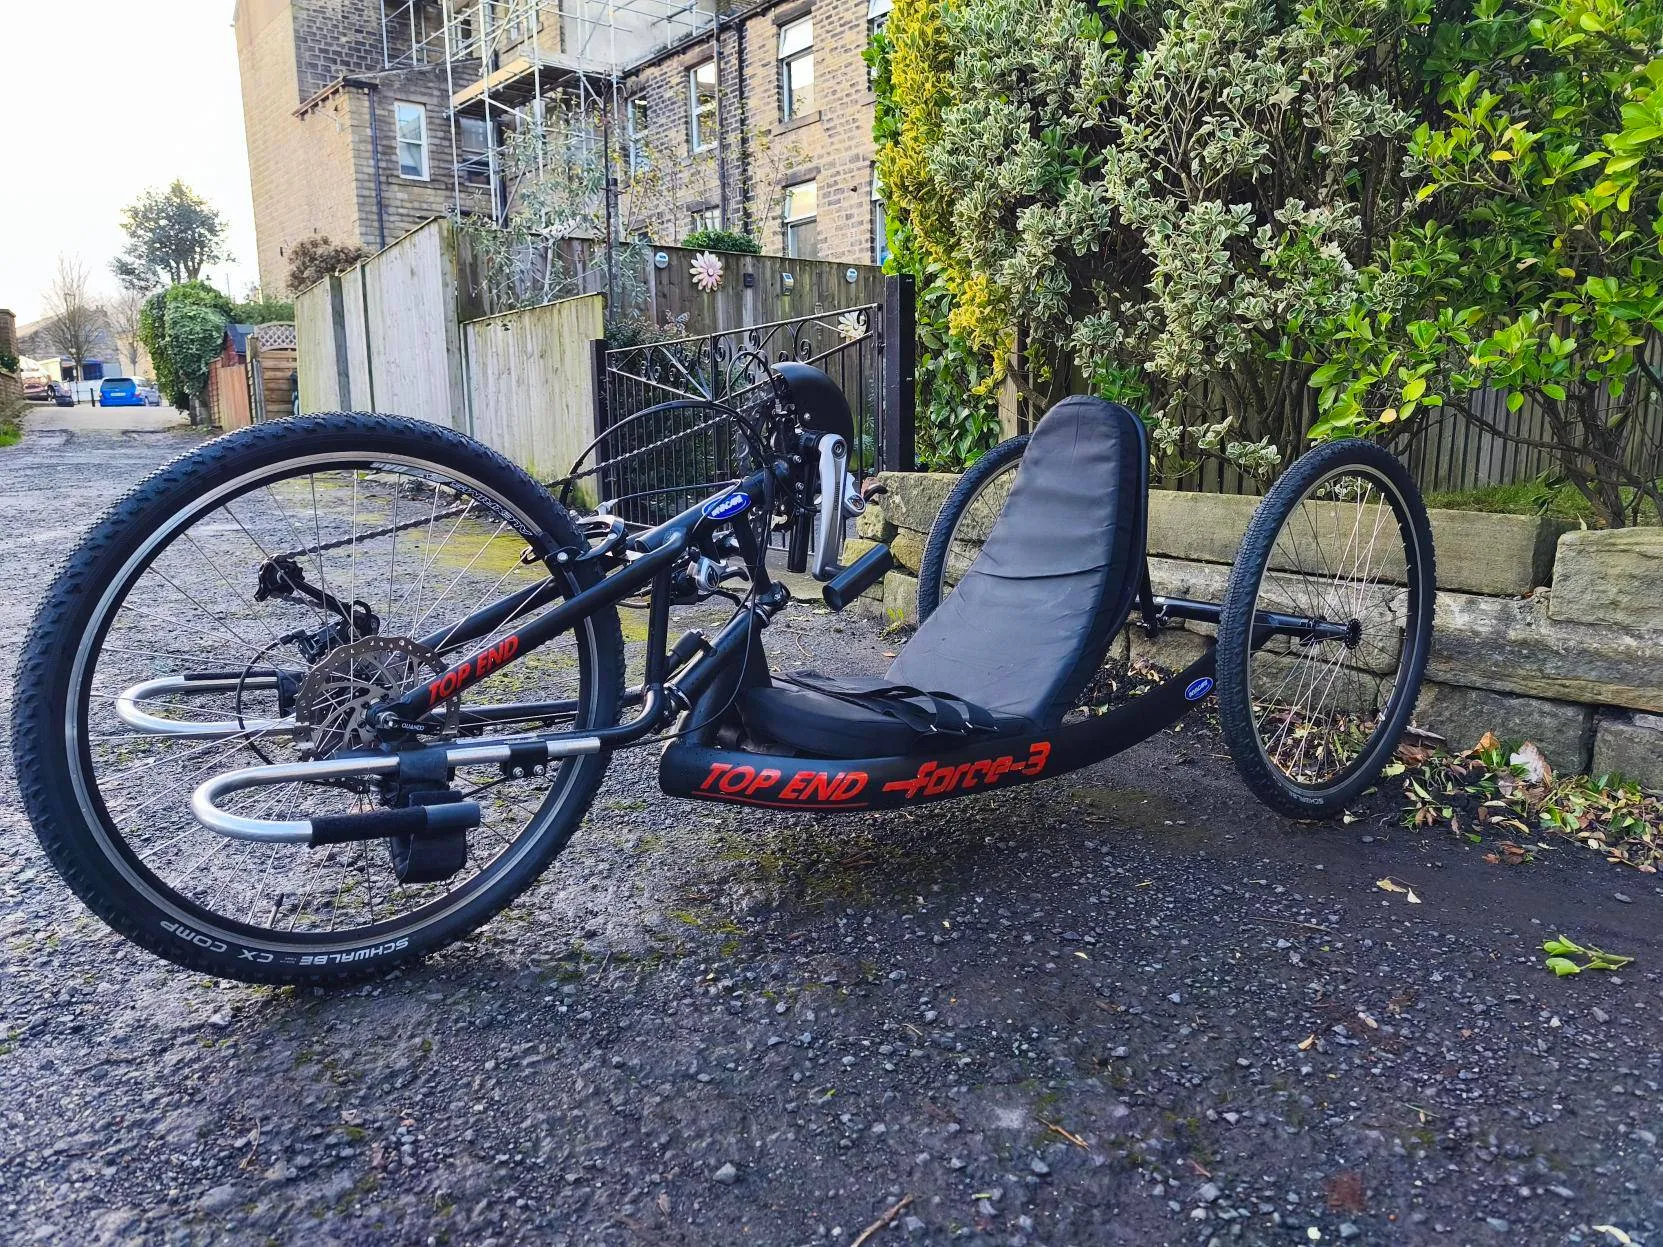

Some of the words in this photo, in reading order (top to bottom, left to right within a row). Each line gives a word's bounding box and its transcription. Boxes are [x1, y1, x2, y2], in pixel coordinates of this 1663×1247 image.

[428, 662, 471, 705] TOP
[475, 634, 519, 678] END
[699, 762, 781, 797] TOP
[778, 771, 869, 801] END
[160, 920, 228, 953] COMP
[299, 936, 409, 966] SCHWALBE
[237, 949, 274, 963] CX
